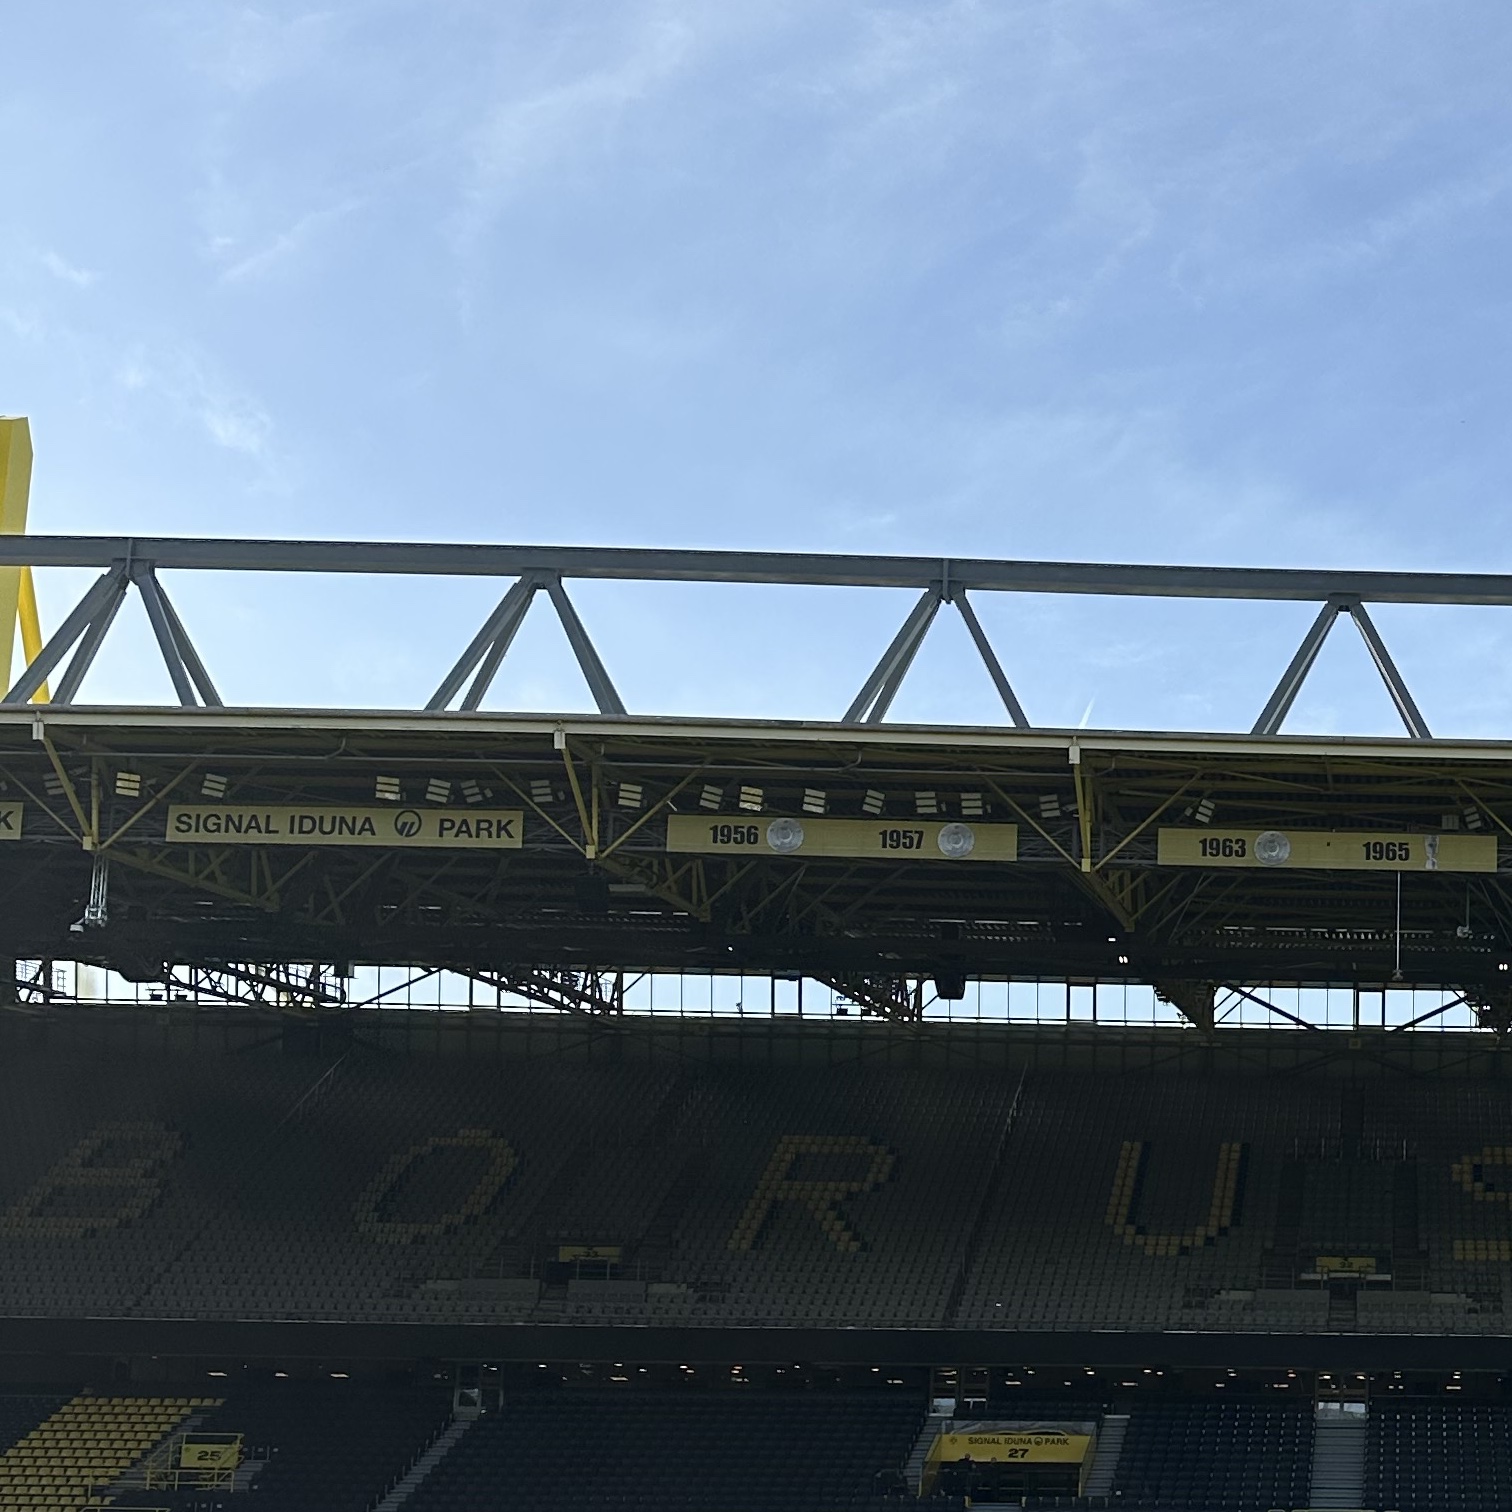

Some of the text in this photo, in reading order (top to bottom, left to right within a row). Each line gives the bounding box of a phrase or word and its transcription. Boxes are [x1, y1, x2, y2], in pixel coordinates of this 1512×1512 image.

[174, 813, 515, 839] SIGNAL IDUNA PARK
[709, 824, 760, 845] 1956
[878, 829, 925, 850] 1957
[1199, 837, 1247, 858] 1963
[1362, 841, 1410, 862] 1965
[967, 1436, 1070, 1446] SIGNAL IDUNA PARK
[197, 1450, 221, 1461] 25
[1008, 1448, 1029, 1459] 27
